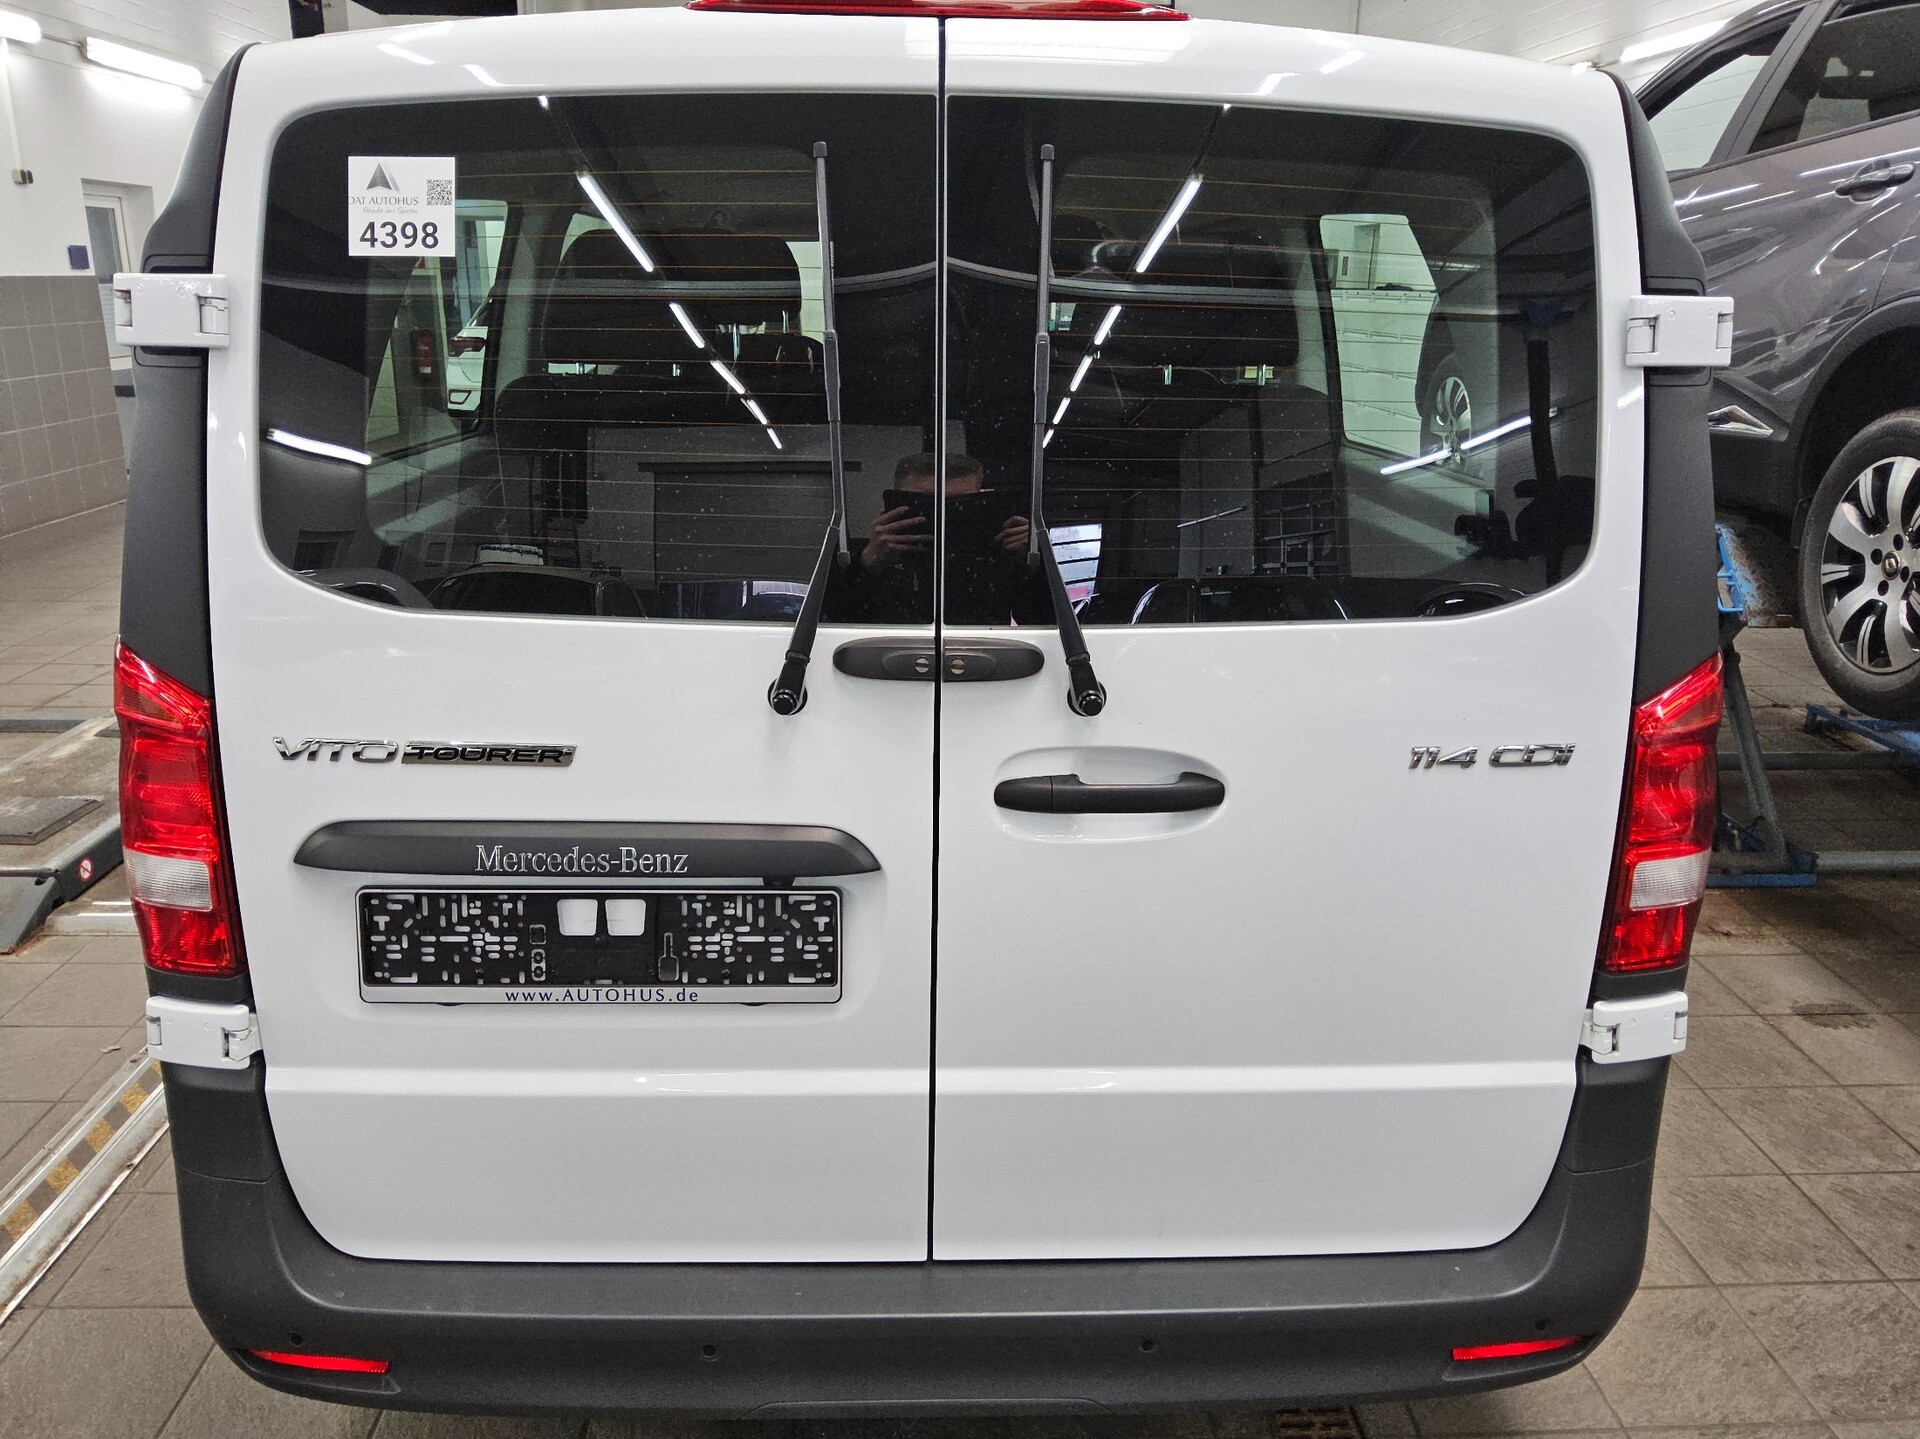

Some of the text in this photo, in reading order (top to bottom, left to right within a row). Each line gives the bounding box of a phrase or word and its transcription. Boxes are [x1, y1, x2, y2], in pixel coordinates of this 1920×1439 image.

[369, 196, 419, 206] AUTOHUS
[360, 221, 439, 249] 4398
[273, 736, 563, 763] VITO TOURER
[1409, 745, 1479, 769] 114
[475, 844, 689, 872] Mercedes-Benz
[505, 988, 699, 1002] www.AUTOHUS.de
